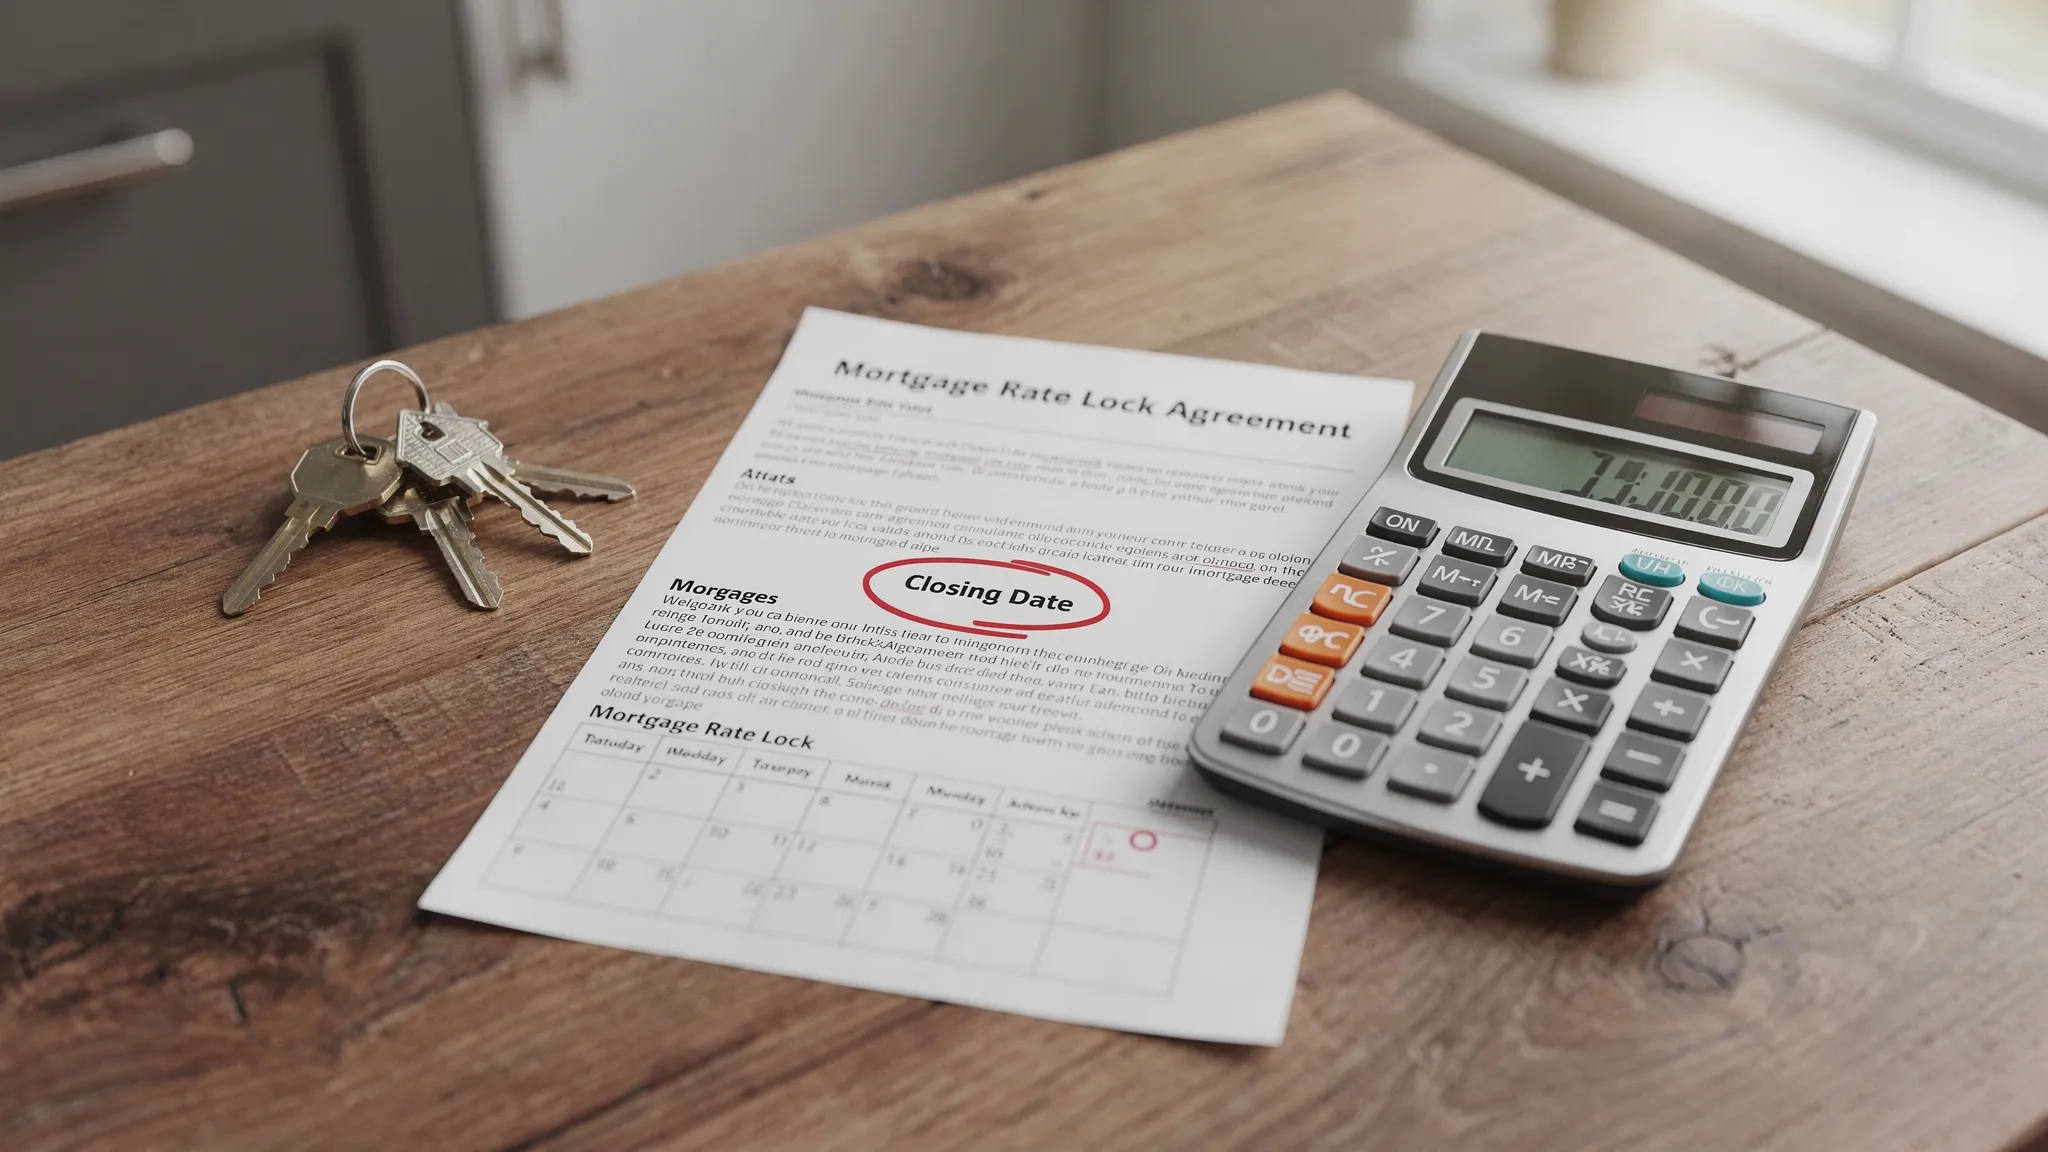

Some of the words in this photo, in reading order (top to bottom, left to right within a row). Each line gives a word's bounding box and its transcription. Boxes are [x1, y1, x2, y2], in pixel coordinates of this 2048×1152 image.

[834, 360, 988, 396] Mortgage
[1000, 381, 1070, 402] Rate
[1082, 391, 1152, 414] Lock
[1166, 401, 1350, 438] Agreement
[1385, 514, 1420, 533] ON
[1188, 565, 1260, 584] imortgage
[1259, 564, 1277, 573] on
[669, 578, 778, 604] Morgages
[904, 574, 1002, 605] Closing
[1008, 588, 1073, 612] Date
[1417, 604, 1447, 626] 7
[785, 628, 813, 638] and
[814, 630, 832, 641] be
[935, 634, 949, 643] to
[1499, 626, 1527, 648] 6
[1389, 648, 1418, 670] 4
[1471, 668, 1501, 690] 5
[813, 688, 836, 699] the
[1364, 689, 1386, 713] 1
[589, 704, 698, 733] Mortgage
[704, 721, 755, 740] Rate
[761, 730, 812, 749] Lock
[1251, 709, 1279, 735] 0
[1443, 711, 1475, 737] 2
[1331, 732, 1362, 758] 0
